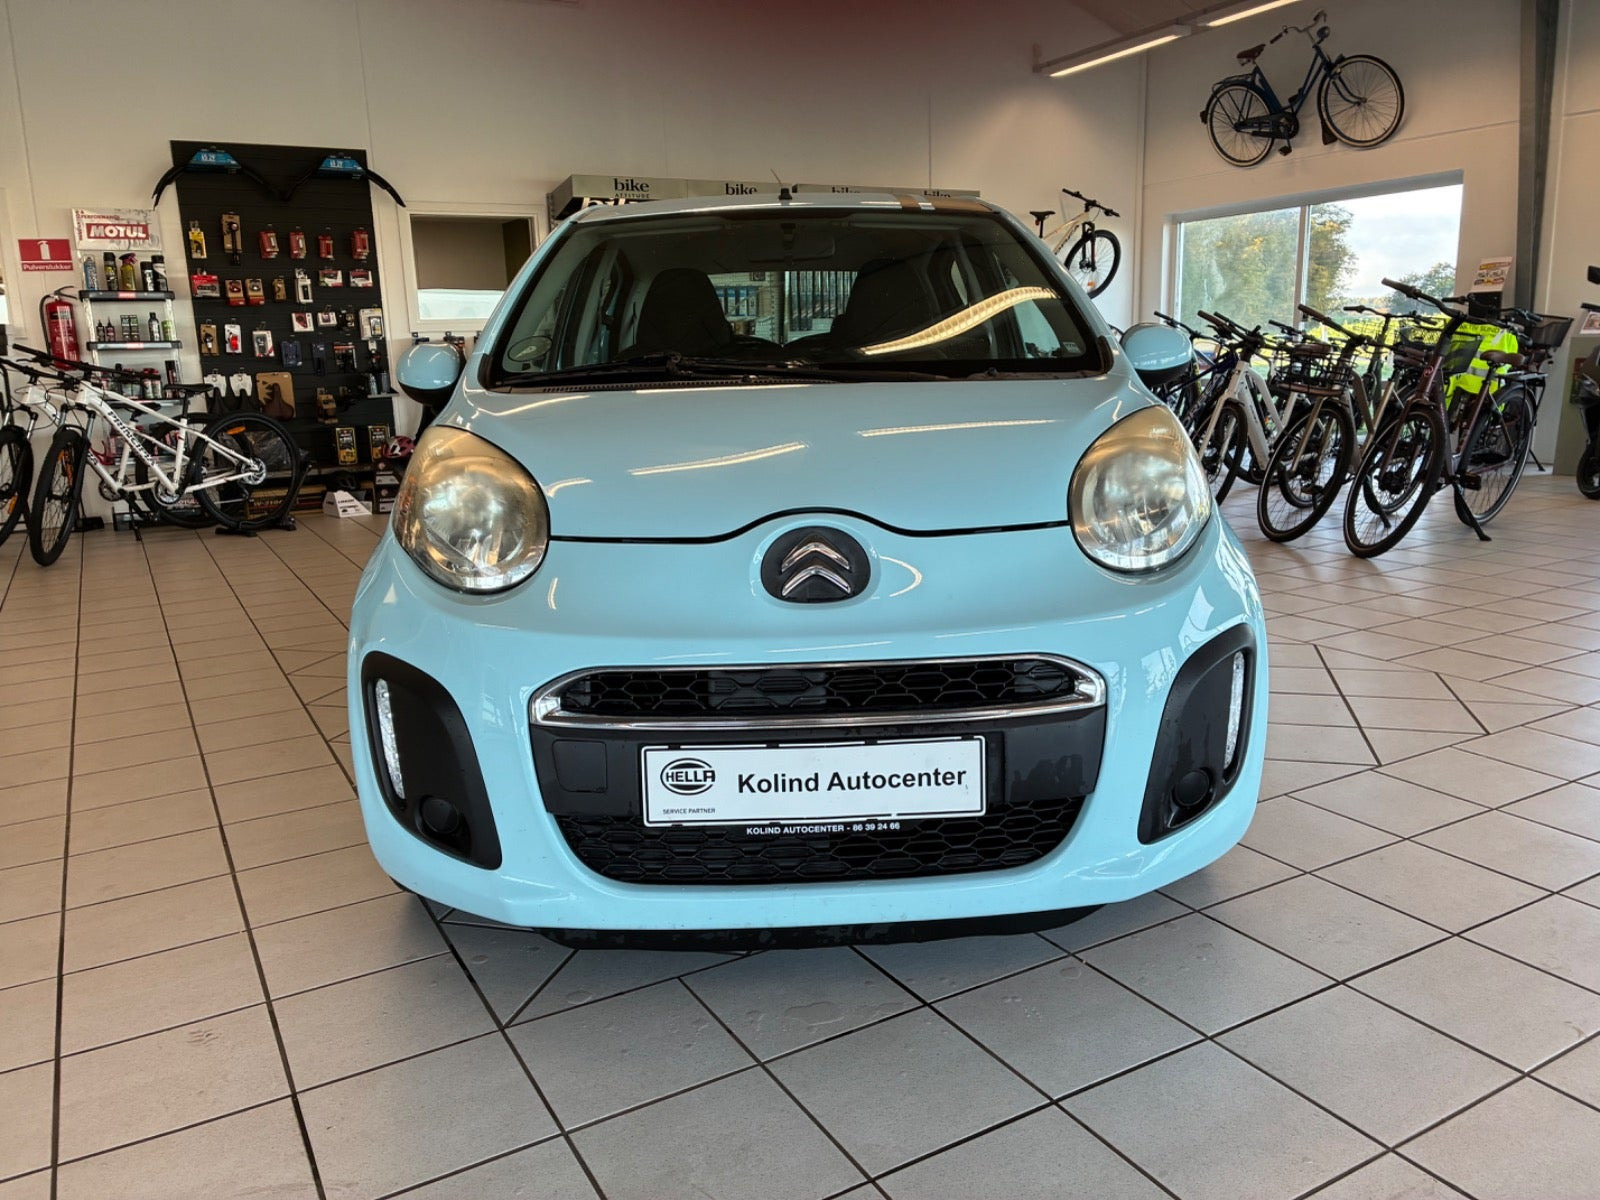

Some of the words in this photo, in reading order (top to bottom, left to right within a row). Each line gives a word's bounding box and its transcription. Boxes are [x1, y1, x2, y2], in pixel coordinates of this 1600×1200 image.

[614, 178, 650, 192] bike
[89, 224, 147, 238] MOTUL
[665, 770, 716, 783] HELLA
[738, 772, 819, 794] Kolind
[826, 767, 967, 792] Autocenter
[746, 827, 781, 836] KOLIND
[783, 823, 845, 834] AUTOCENTER
[865, 823, 876, 831] 39
[877, 822, 888, 830] 24
